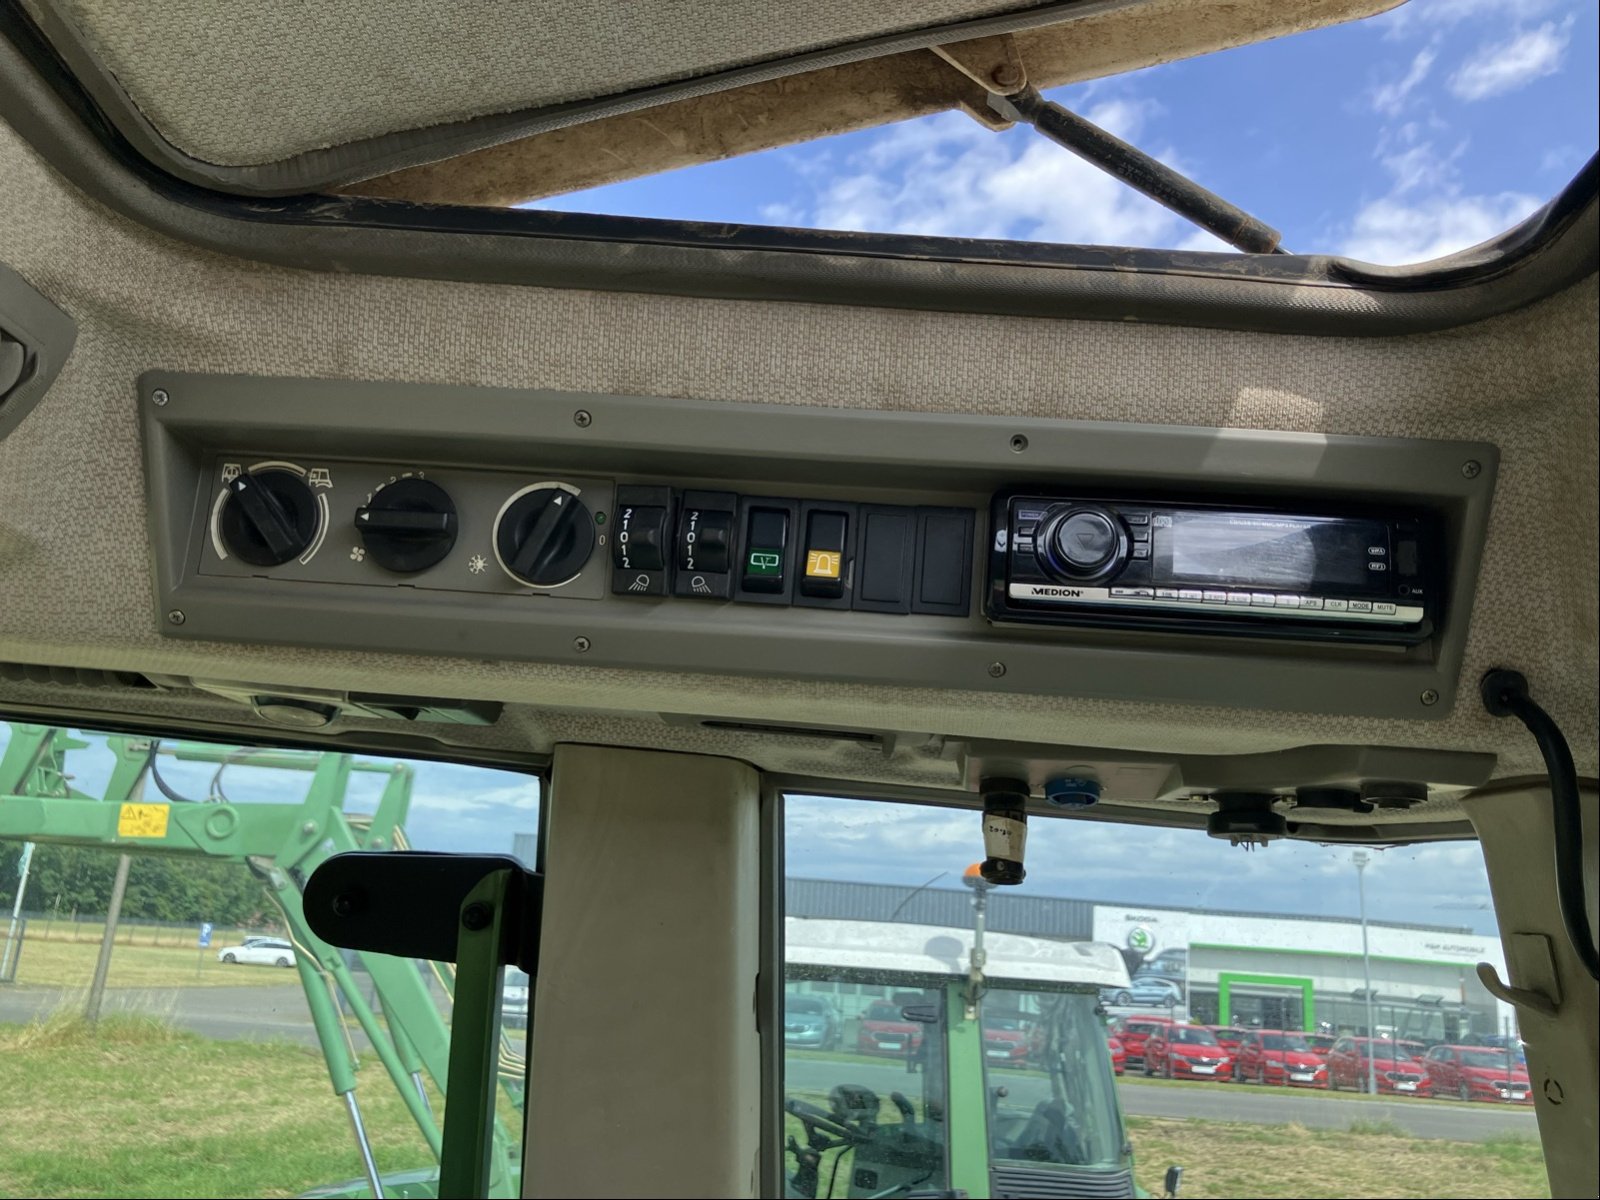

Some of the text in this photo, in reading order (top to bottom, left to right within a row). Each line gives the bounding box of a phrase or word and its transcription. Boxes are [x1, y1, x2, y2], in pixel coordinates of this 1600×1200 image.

[623, 508, 633, 519] 2
[690, 511, 699, 520] 2
[623, 519, 629, 530] 1
[690, 520, 696, 531] 1
[619, 531, 629, 543] 0
[686, 532, 696, 543] 0
[621, 544, 627, 556] 1
[687, 544, 693, 556] 1
[622, 557, 631, 569] 2
[687, 558, 694, 569] 2
[1031, 587, 1081, 598] MEDION
[1352, 602, 1369, 610] MODE
